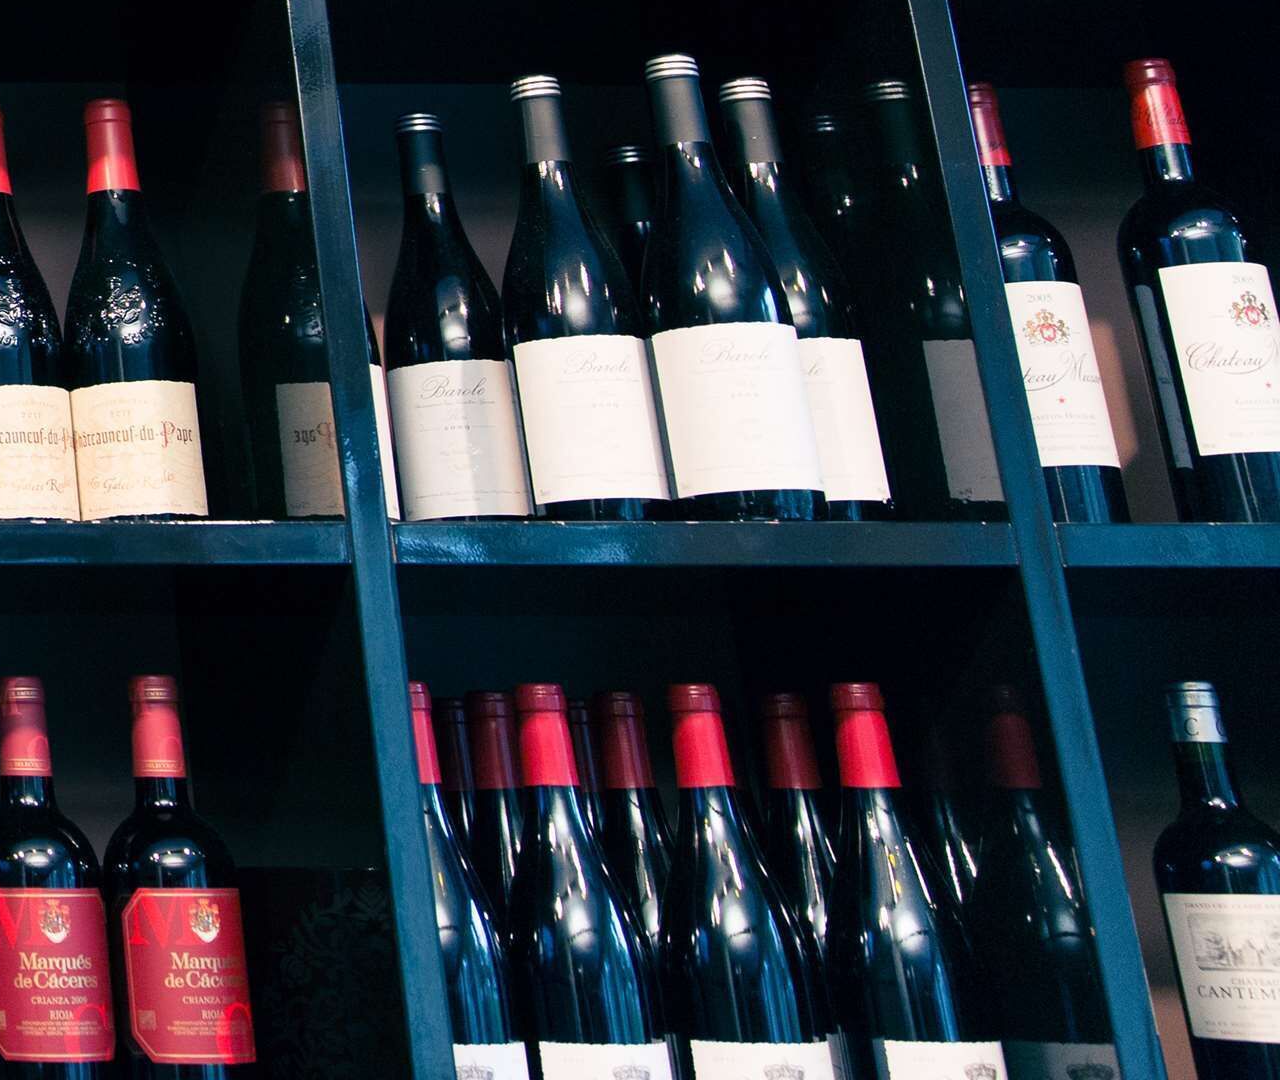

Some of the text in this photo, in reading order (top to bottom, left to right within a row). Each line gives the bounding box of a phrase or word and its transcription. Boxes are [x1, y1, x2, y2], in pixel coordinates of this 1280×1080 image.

[421, 375, 487, 400] Barolo
[18, 951, 93, 973] Marqués
[13, 970, 98, 989] de Cáceres
[164, 972, 185, 989] de
[31, 995, 70, 1006] CRIANZA
[182, 995, 221, 1006] CRIANZA
[49, 1009, 74, 1020] RIOJA
[201, 1009, 225, 1020] RIOJA
